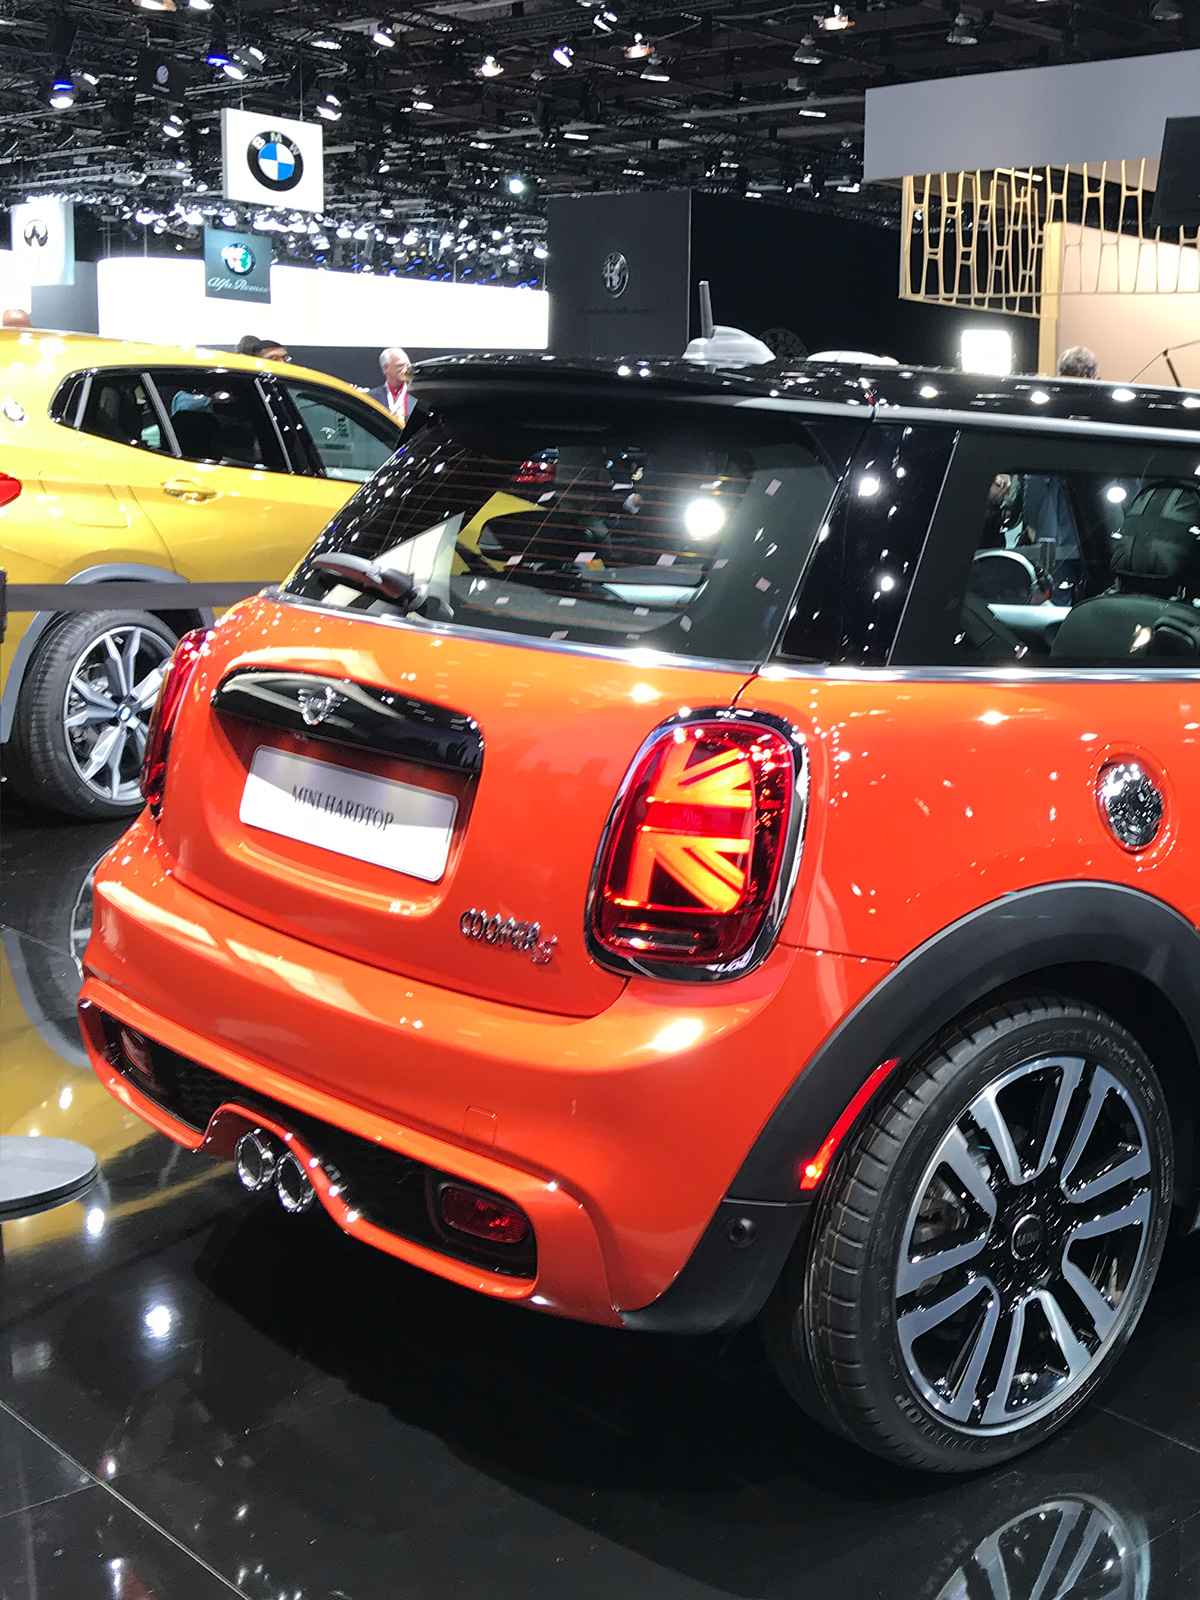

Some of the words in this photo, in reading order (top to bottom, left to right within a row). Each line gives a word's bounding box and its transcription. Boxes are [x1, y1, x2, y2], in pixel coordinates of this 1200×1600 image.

[250, 131, 301, 156] BMW
[207, 276, 232, 293] Alfa
[233, 278, 269, 293] Romeo
[291, 784, 323, 810] MINI
[324, 794, 395, 831] HARDTOP
[459, 907, 541, 951] COOPER
